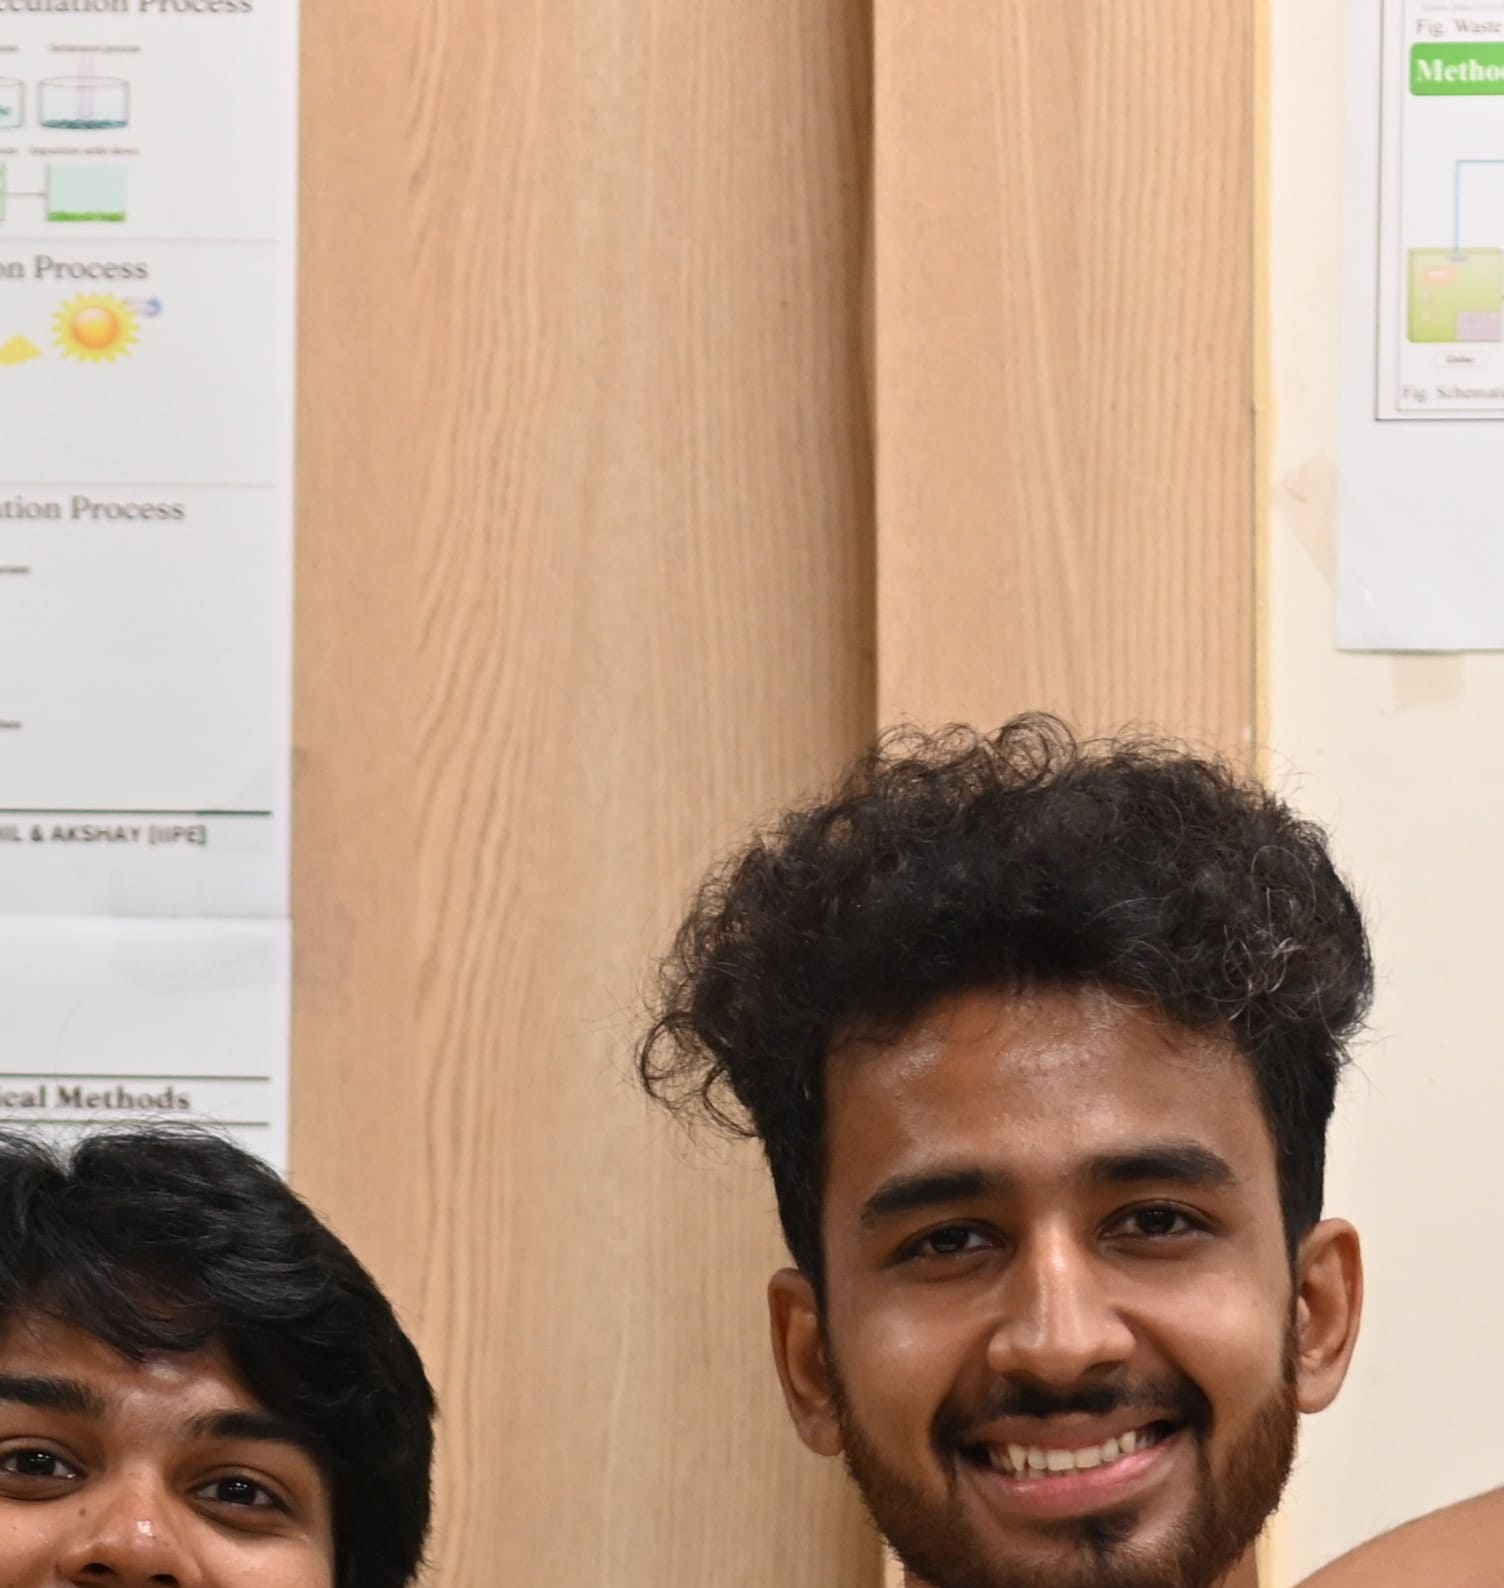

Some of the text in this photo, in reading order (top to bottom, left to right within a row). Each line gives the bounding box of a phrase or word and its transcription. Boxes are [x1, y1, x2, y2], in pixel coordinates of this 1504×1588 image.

[30, 255, 149, 281] Process
[67, 496, 185, 522] Process
[30, 824, 43, 844] &
[50, 825, 143, 845] AKSHAY
[52, 1083, 191, 1112] Methods
